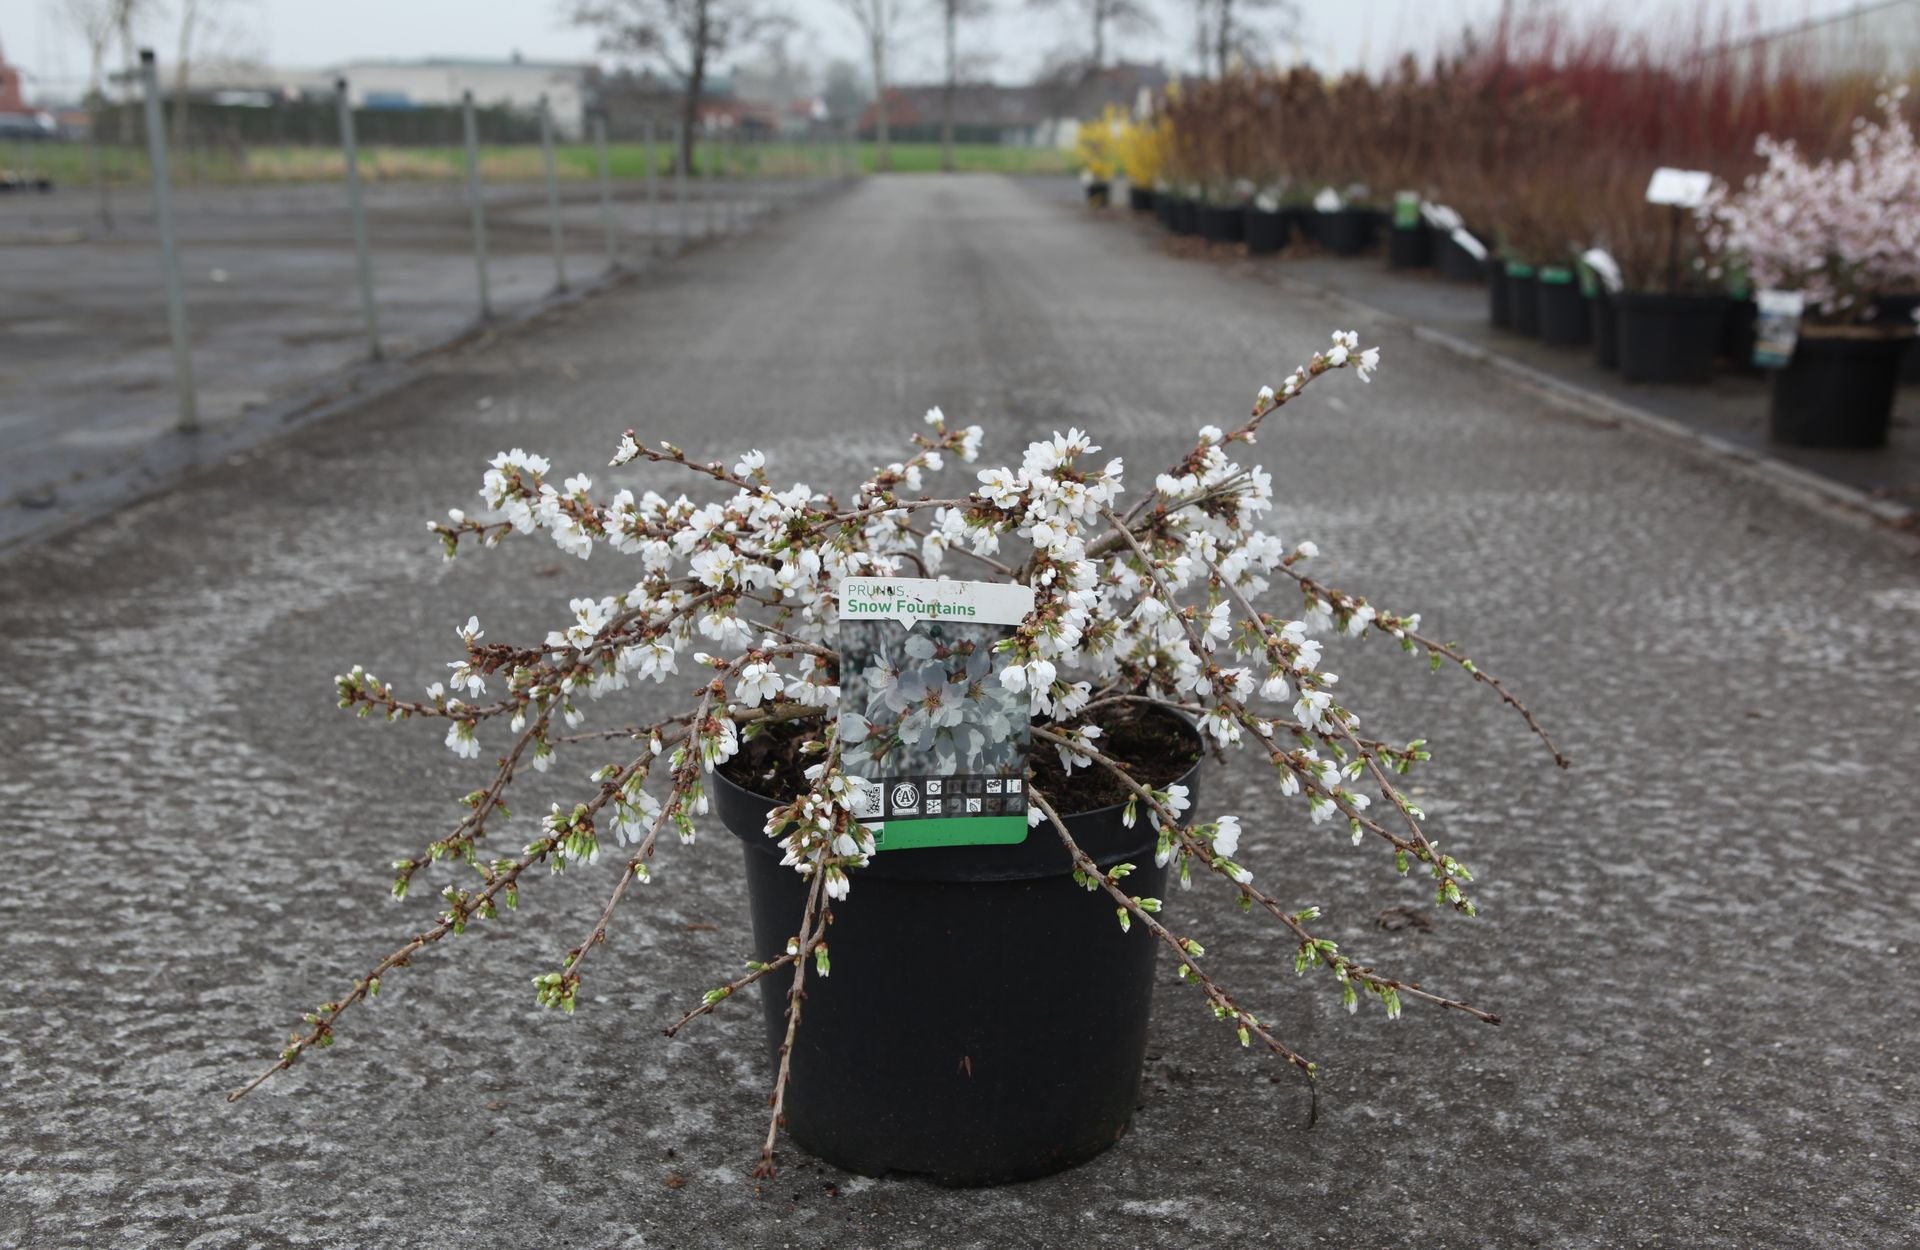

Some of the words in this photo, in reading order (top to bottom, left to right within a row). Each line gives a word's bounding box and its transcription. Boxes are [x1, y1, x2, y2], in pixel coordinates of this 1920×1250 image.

[848, 584, 905, 597] PRUNUS
[848, 600, 892, 613] Snow
[897, 600, 976, 616] Fountains
